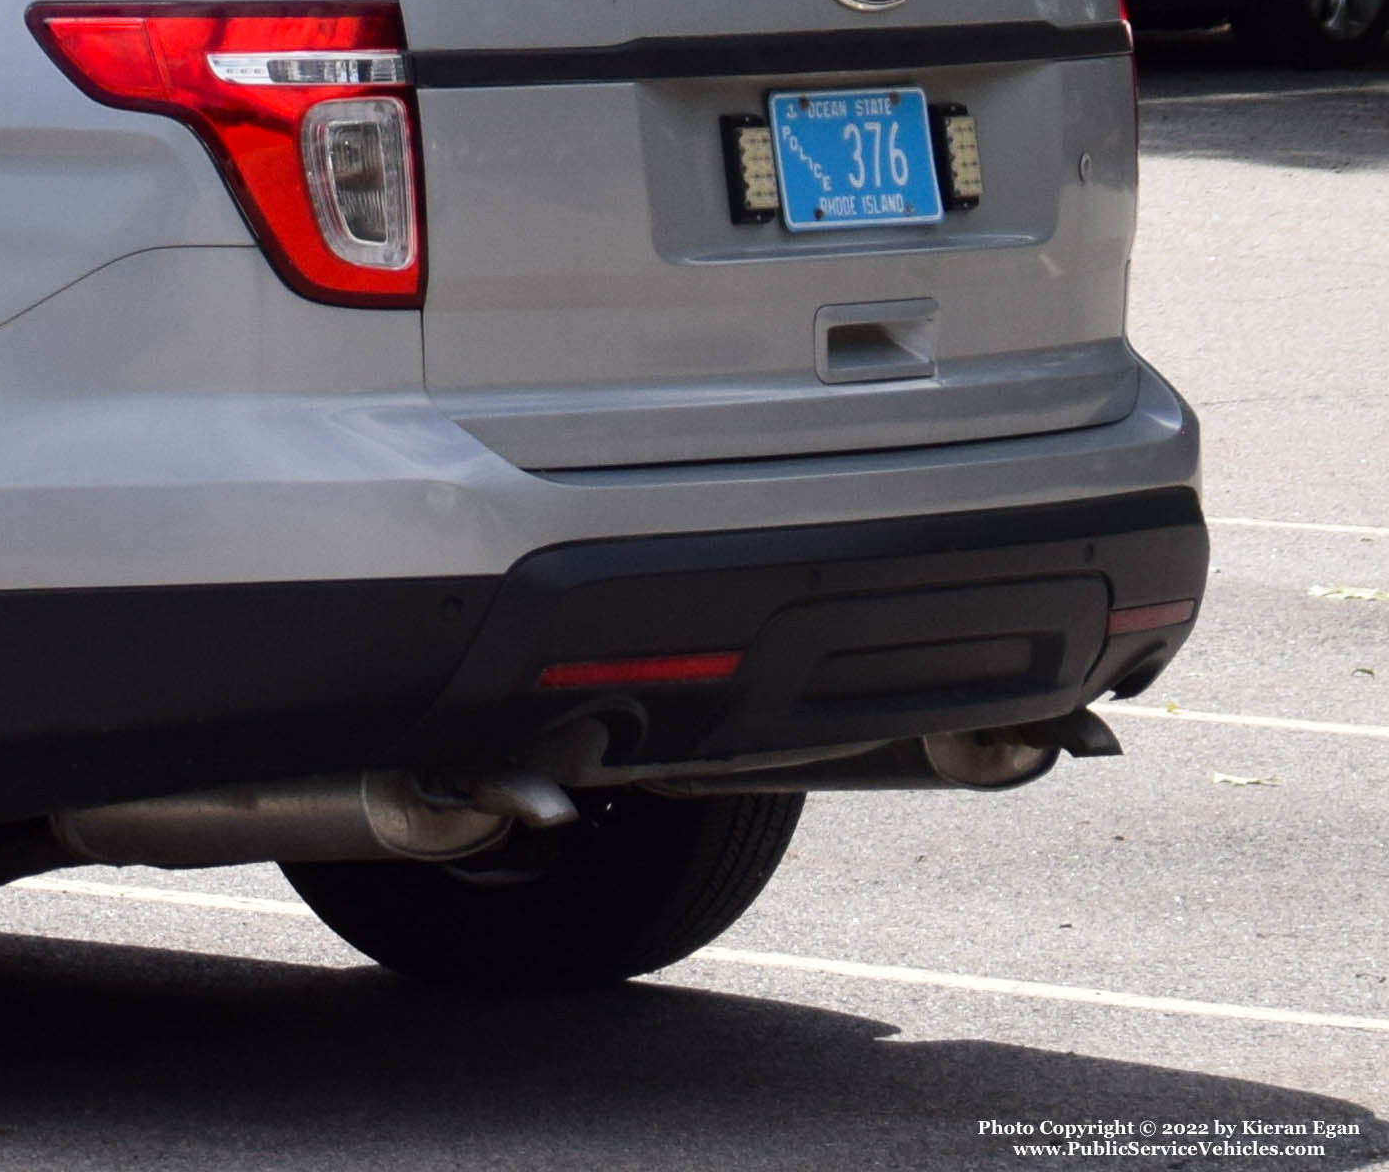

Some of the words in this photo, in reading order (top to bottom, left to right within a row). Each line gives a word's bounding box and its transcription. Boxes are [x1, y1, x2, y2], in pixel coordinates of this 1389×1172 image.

[807, 99, 847, 119] OCEAN
[854, 96, 893, 117] STATE
[780, 124, 833, 192] POLICE
[841, 120, 910, 189] 376
[819, 195, 858, 217] RHODE
[861, 192, 905, 216] ISLAND
